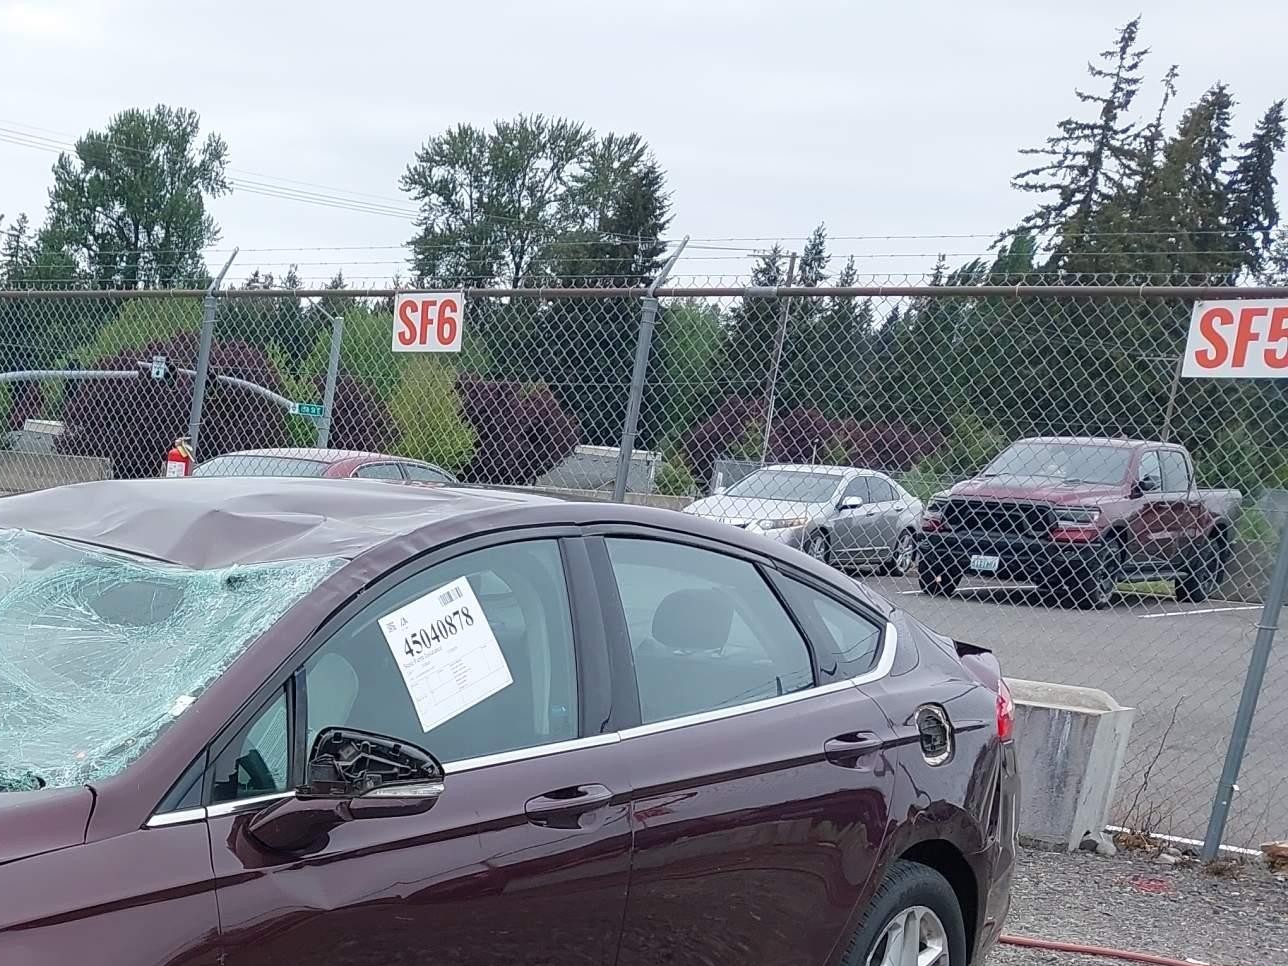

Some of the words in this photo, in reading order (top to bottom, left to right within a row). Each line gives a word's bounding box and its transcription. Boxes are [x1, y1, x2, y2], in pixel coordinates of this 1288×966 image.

[397, 298, 458, 347] SF6
[1194, 306, 1288, 370] SF5
[404, 606, 474, 657] 45040878
